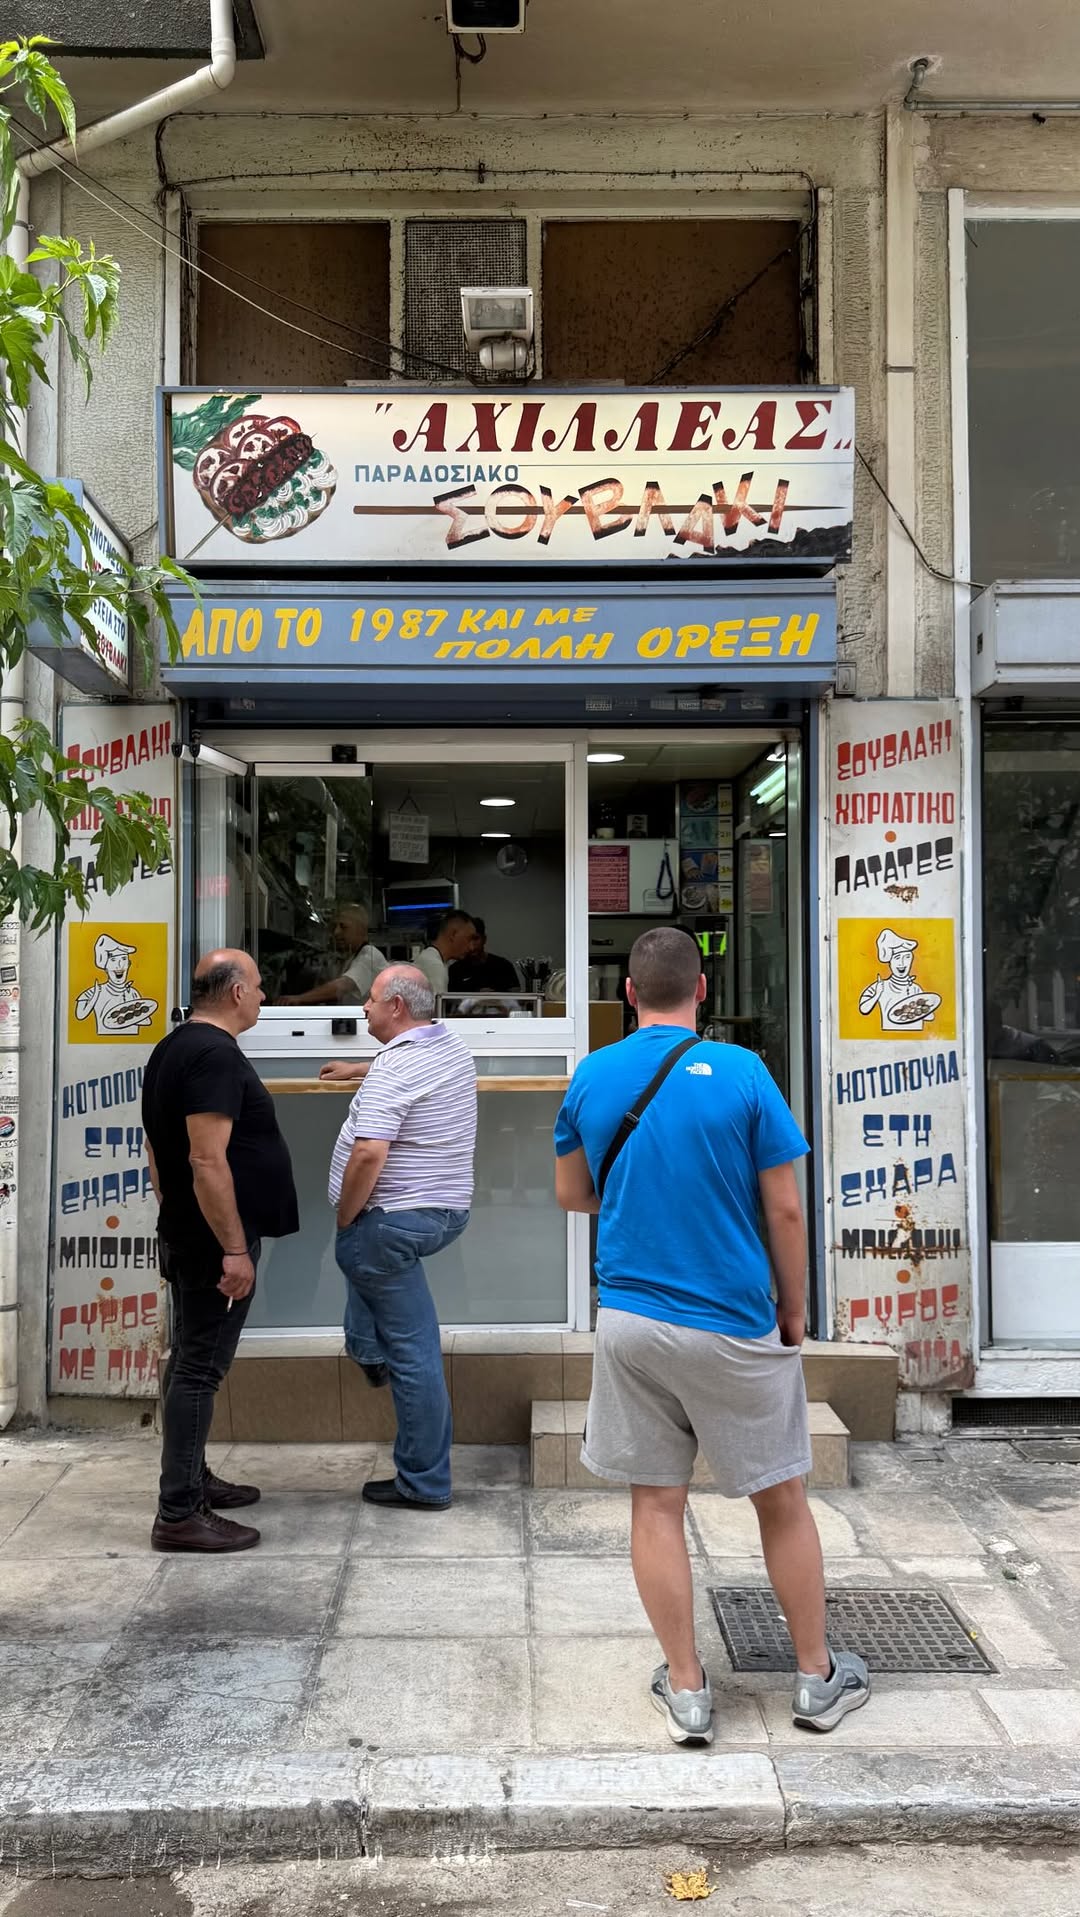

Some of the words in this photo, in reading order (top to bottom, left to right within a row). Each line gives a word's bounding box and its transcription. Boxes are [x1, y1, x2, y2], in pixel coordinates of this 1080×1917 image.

[354, 463, 520, 483] ΠΑΡΑΔΟΣΙΑΚΟ
[432, 471, 791, 554] ΣΟΥΒΛΑΚΙ
[113, 613, 126, 642] ΣΤΟ
[181, 607, 264, 657] ΑΠΟ
[273, 607, 323, 649] ΤΟ
[349, 608, 449, 642] 1987
[457, 608, 526, 634] ΚΑΙ
[533, 607, 599, 627] ΜΕ
[433, 632, 615, 660] ΠΟΛΛΗ
[636, 613, 820, 659] ΟΡΕΞΗ
[837, 719, 953, 782] ΣΟΥΒΛΑΚΙ
[835, 792, 955, 825] ΧΩΡΙΑΤΙΚΟ
[834, 836, 954, 896] ΠΑΤΑΤΕΣ
[836, 1050, 959, 1104] ΚΟΤΟΠΟΥΛΑ
[85, 1126, 143, 1158] ΣΤΗ
[863, 1114, 932, 1147] ΣΤΗ
[840, 1152, 958, 1208] ΣΧΑΡΑ
[59, 1236, 158, 1269] ΜΠΙΦΤΕΚ
[59, 1291, 158, 1341] ΓΥΡΟΣ
[850, 1284, 959, 1333] ΓΥΡΟΣ
[59, 1347, 96, 1380] ΜΕ
[108, 1348, 160, 1381] ΠΙΤΑ
